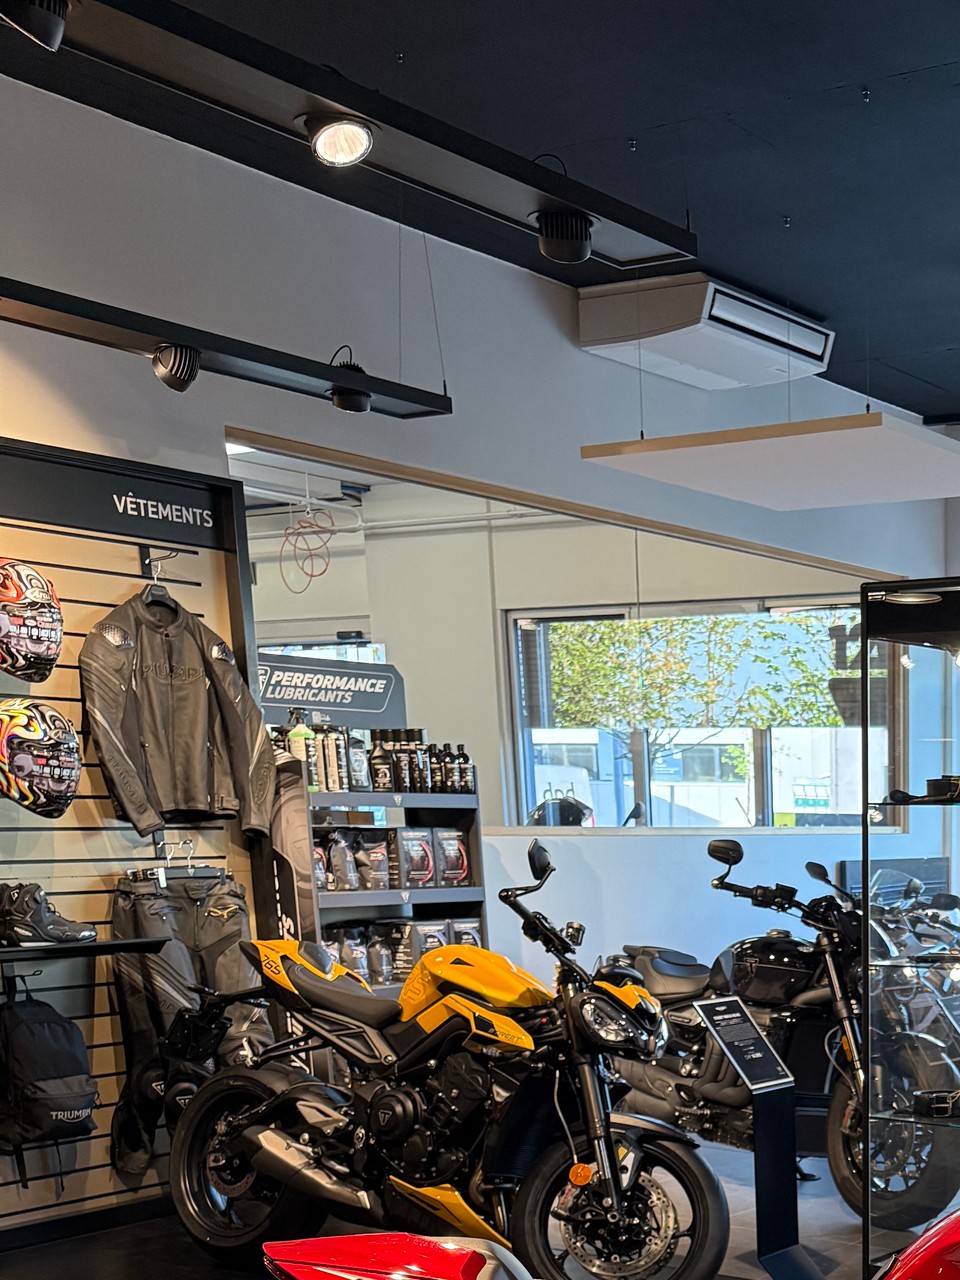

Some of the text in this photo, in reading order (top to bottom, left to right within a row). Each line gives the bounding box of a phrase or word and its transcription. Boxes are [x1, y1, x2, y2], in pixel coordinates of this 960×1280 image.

[113, 491, 214, 528] VÊTEMENTS
[270, 671, 387, 693] PERFORMANCE
[265, 685, 354, 704] LUBRICANTS
[50, 1107, 91, 1121] TRIUMPH
